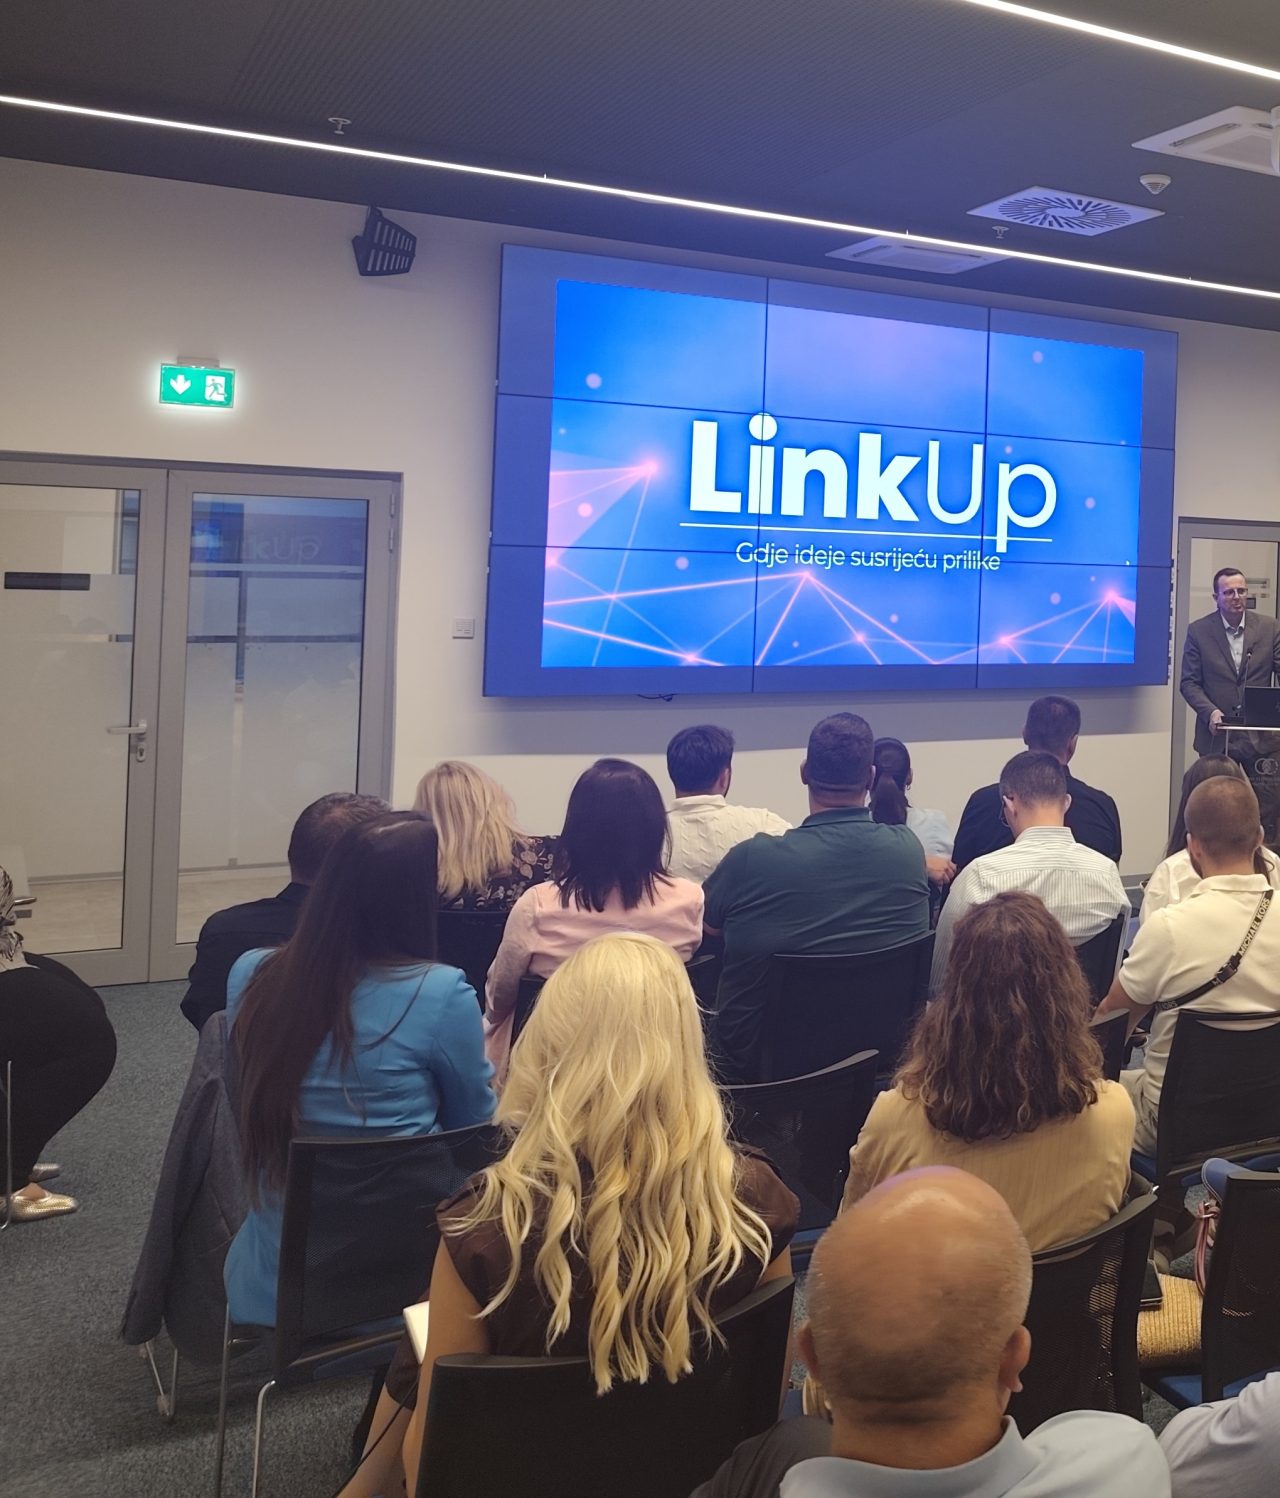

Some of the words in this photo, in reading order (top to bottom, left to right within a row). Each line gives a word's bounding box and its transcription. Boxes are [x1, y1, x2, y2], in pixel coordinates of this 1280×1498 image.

[690, 412, 1057, 553] LinkUp
[736, 542, 788, 568] Gdje
[794, 544, 845, 569] ideje
[850, 548, 937, 572] susrijeću
[943, 549, 1001, 573] prilike
[1238, 920, 1260, 957] MICHAEL
[1256, 898, 1270, 920] KORS
